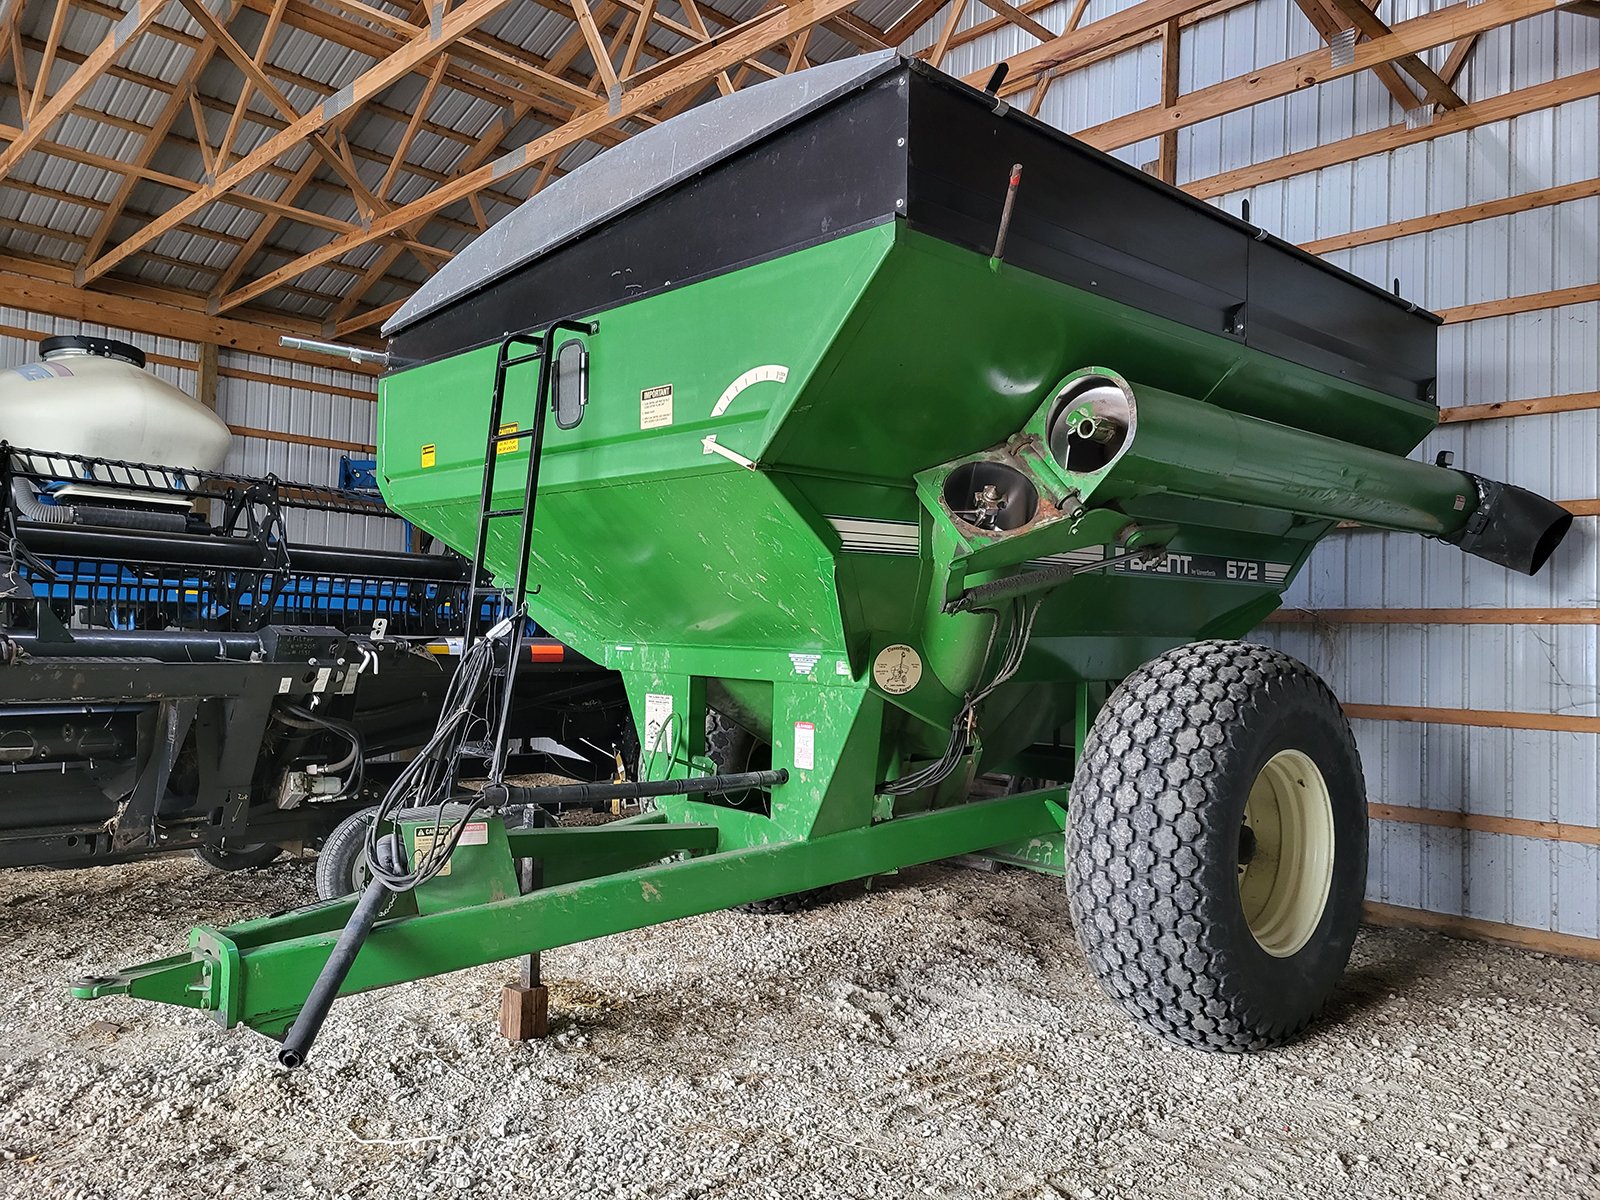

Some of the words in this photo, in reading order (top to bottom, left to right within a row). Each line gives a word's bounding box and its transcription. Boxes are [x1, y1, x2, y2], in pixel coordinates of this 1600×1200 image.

[643, 387, 670, 399] IMPORTANT
[1226, 560, 1258, 580] 672
[425, 827, 448, 835] CAUION
